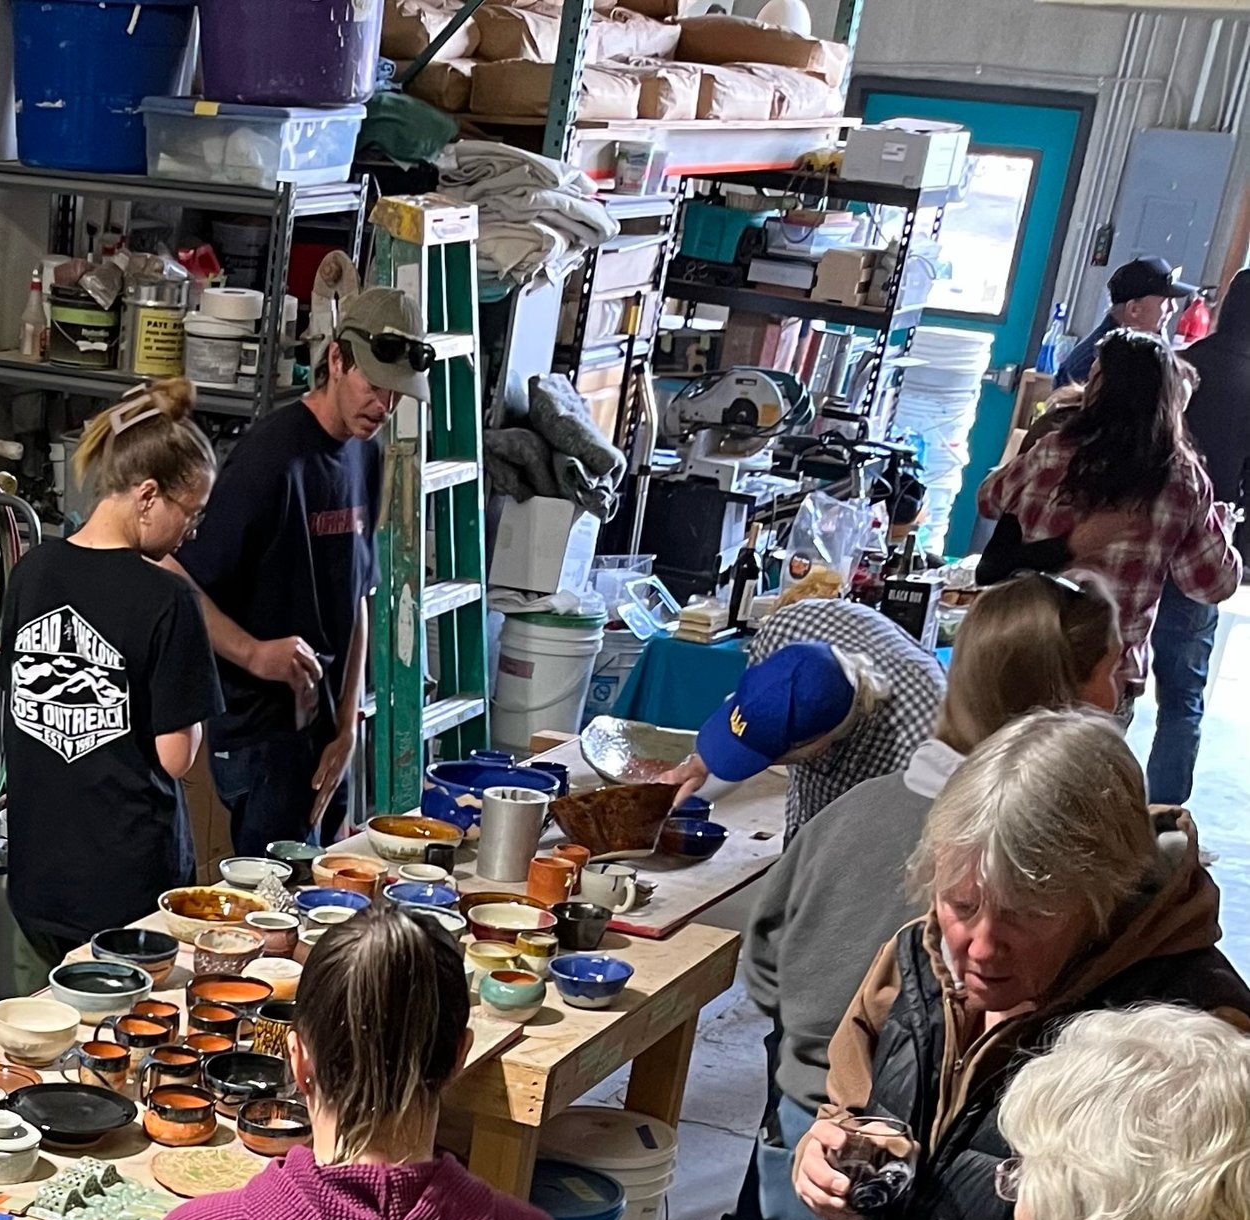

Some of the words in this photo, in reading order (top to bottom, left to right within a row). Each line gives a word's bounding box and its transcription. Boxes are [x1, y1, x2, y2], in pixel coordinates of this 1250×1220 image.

[888, 589, 909, 601] BLACK
[15, 613, 62, 652] PREAD
[91, 634, 119, 666] LOVE
[43, 704, 124, 735] OUTREACH
[44, 729, 62, 750] EST
